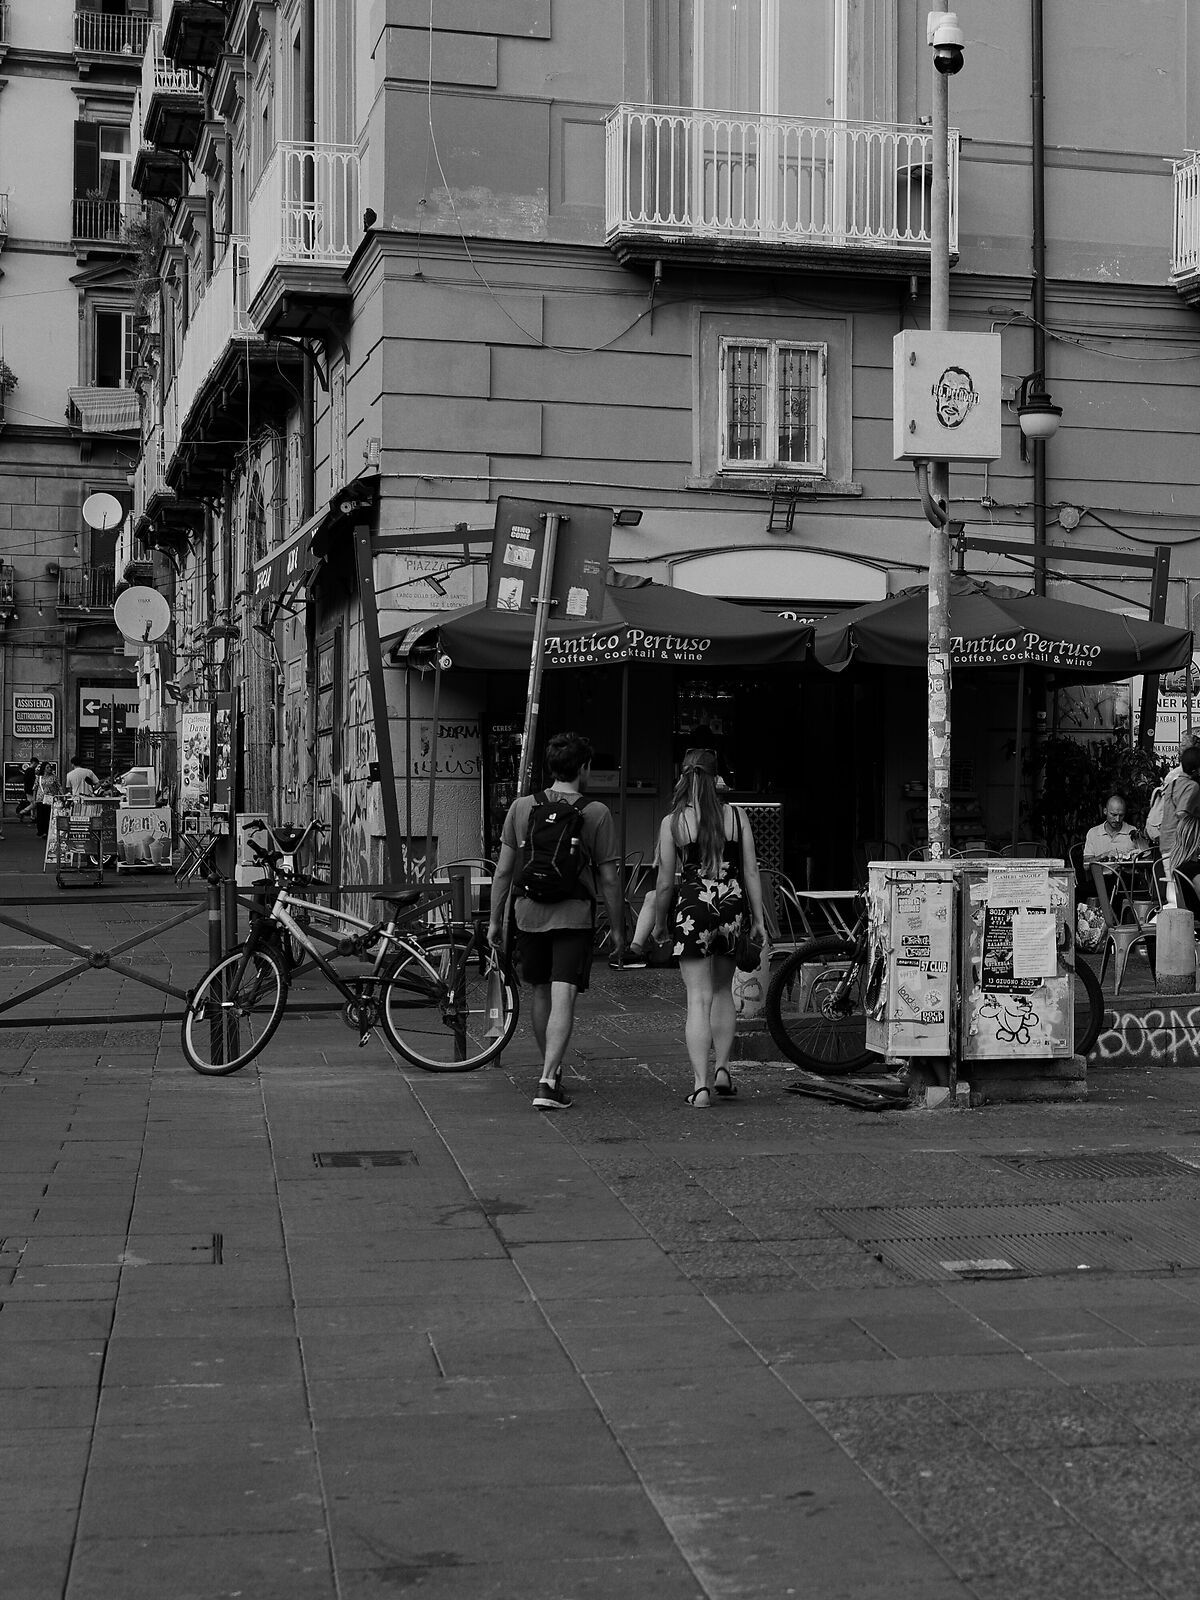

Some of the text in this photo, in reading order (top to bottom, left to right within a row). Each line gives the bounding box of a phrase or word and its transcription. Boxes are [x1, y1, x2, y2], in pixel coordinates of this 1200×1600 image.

[406, 560, 446, 571] PIAZZA
[544, 629, 711, 654] Antico Pertuso
[949, 633, 1101, 658] Antico Pertuso
[551, 647, 703, 664] coffee, cocktail & wine
[953, 650, 1093, 667] coffee, cocktail & wine
[17, 699, 51, 708] ASSISTENZA
[921, 962, 928, 971] 57
[930, 962, 948, 972] CLUB
